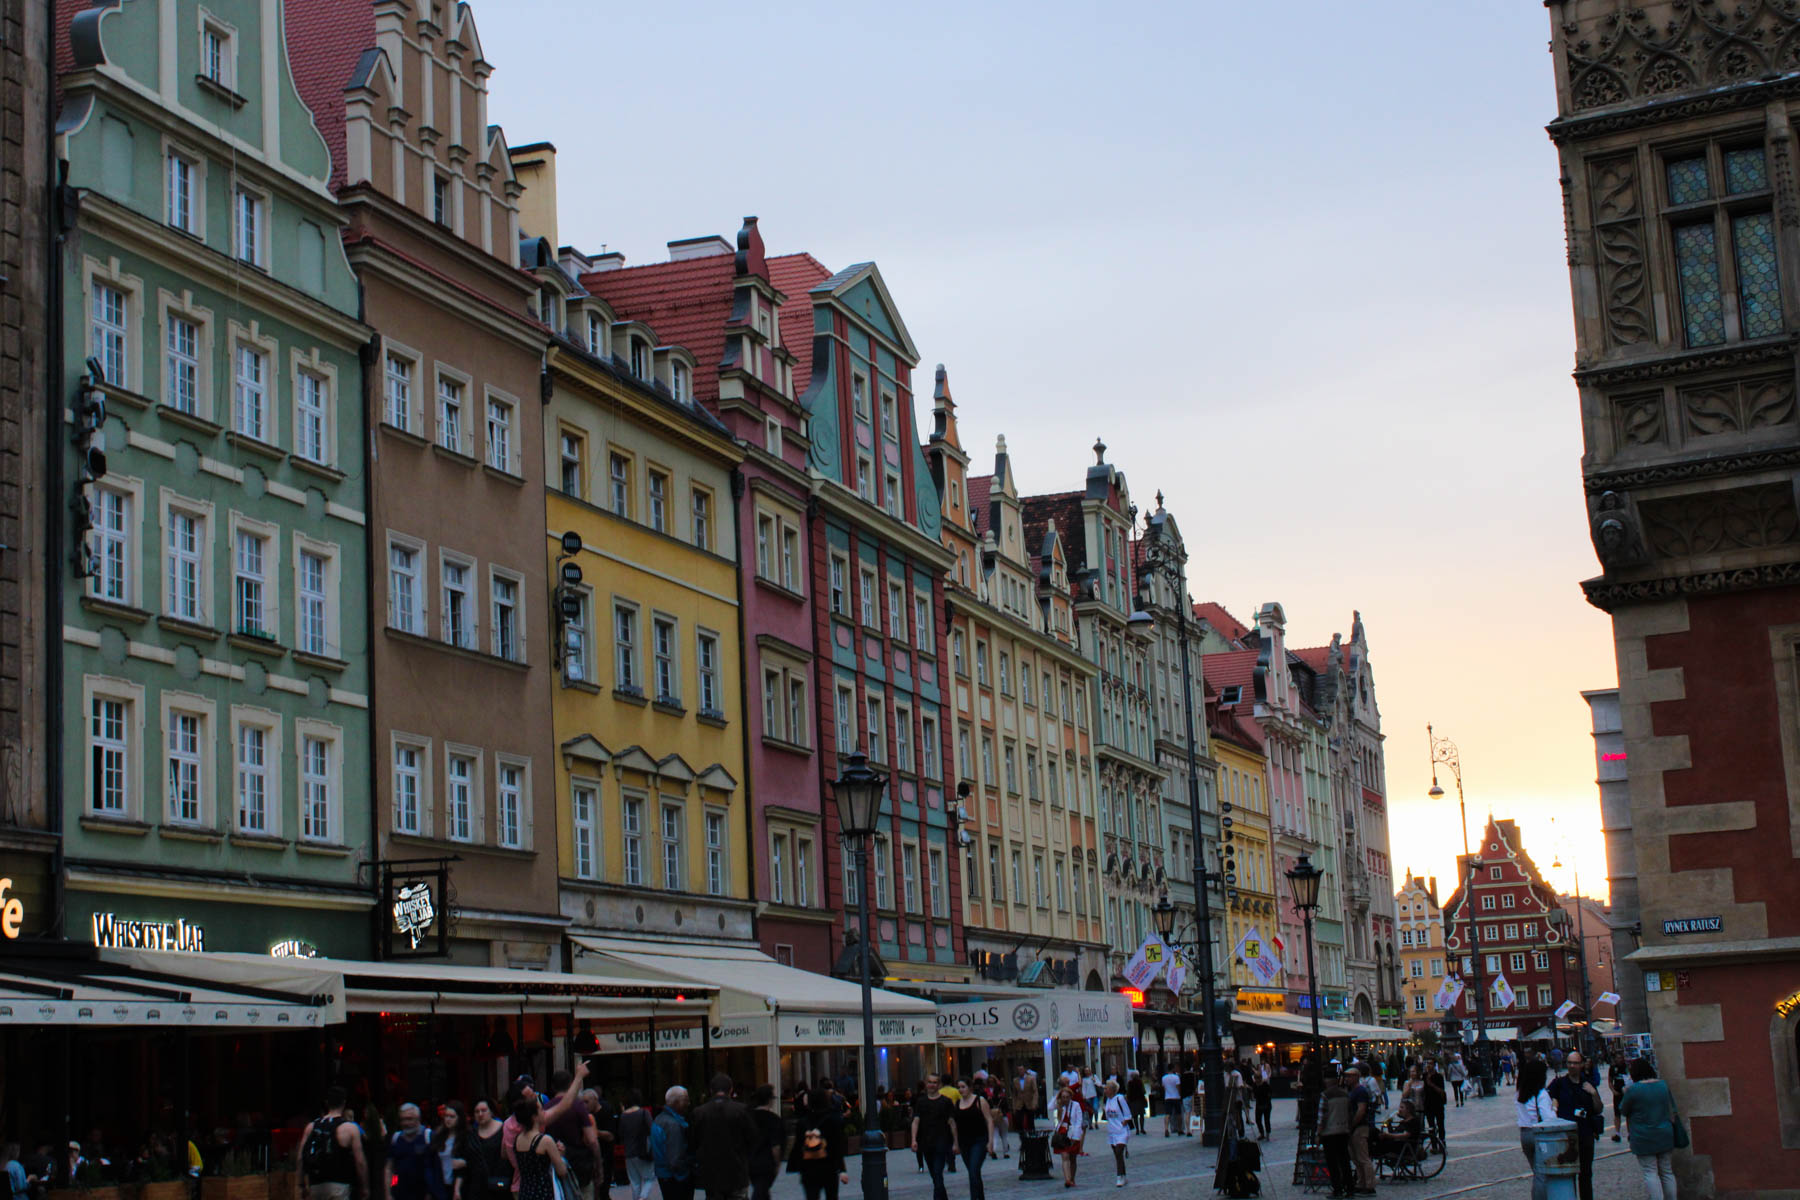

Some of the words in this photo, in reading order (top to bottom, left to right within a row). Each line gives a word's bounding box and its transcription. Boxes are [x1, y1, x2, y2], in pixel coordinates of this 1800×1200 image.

[393, 895, 430, 917] WHISKEY
[1665, 920, 1689, 933] RYNEK
[1690, 919, 1720, 931] RATUSZ
[724, 1024, 750, 1037] pepsi
